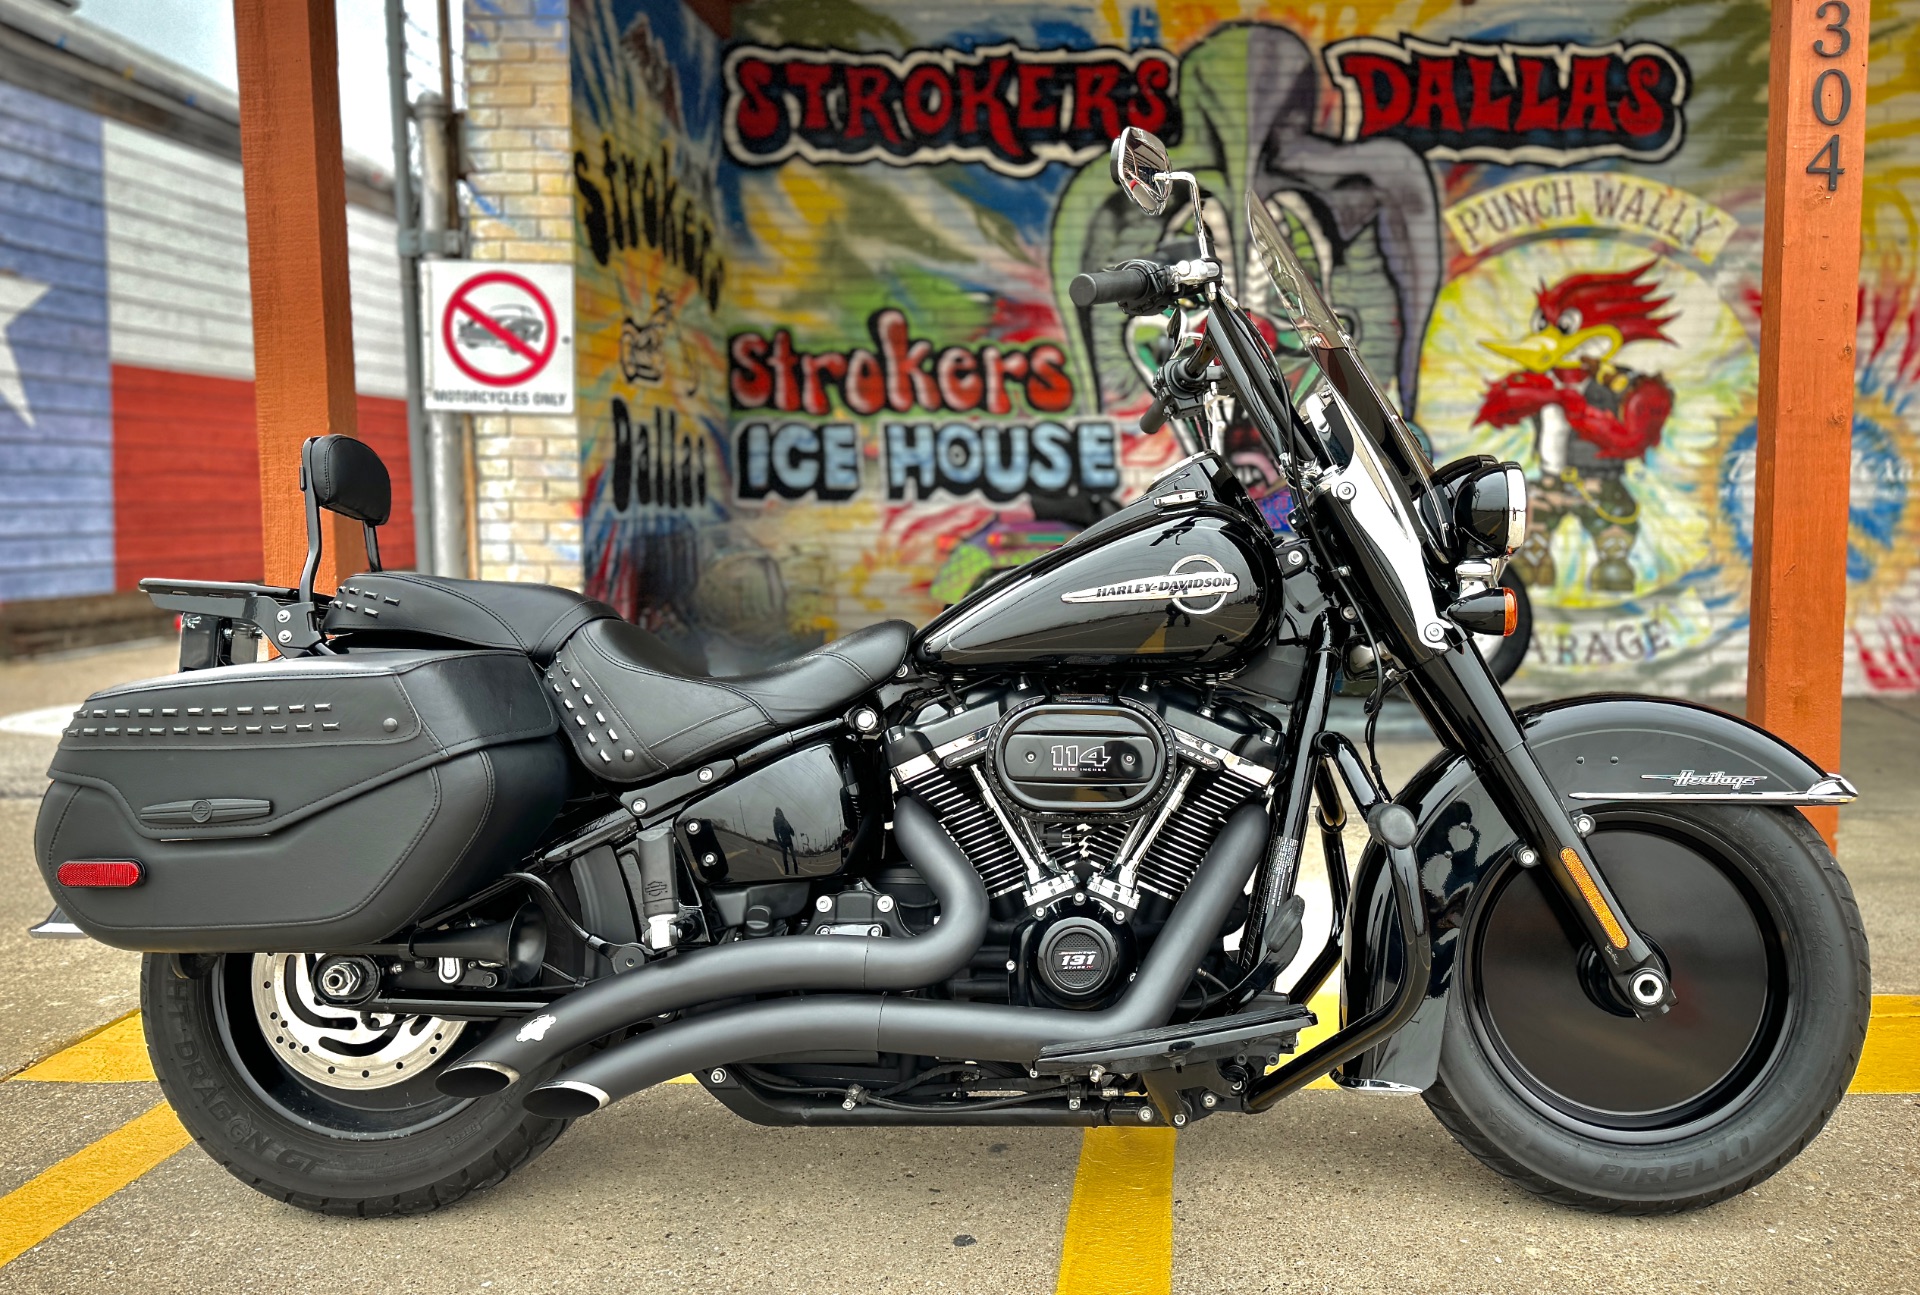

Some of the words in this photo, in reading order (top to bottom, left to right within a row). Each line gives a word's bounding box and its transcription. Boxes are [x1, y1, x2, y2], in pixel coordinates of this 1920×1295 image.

[738, 57, 1170, 158] STROKERS
[1343, 56, 1665, 138] DALLAS
[1806, 0, 1852, 191] 304
[1455, 179, 1576, 248] PUNCH
[1593, 178, 1720, 246] WALLY
[731, 309, 1075, 415] Strokers
[432, 389, 530, 406] MOTORCYCLES
[532, 391, 567, 407] ONLY
[746, 422, 859, 490] ICE
[886, 421, 1119, 493] HOUSE
[1096, 577, 1231, 598] HARLEY-DAVIDSON
[1530, 617, 1671, 666] ARAGE
[1050, 744, 1112, 767] 114
[1673, 769, 1756, 790] Heritage
[1061, 954, 1096, 966] 131
[1592, 1135, 1751, 1186] PIRELLI
